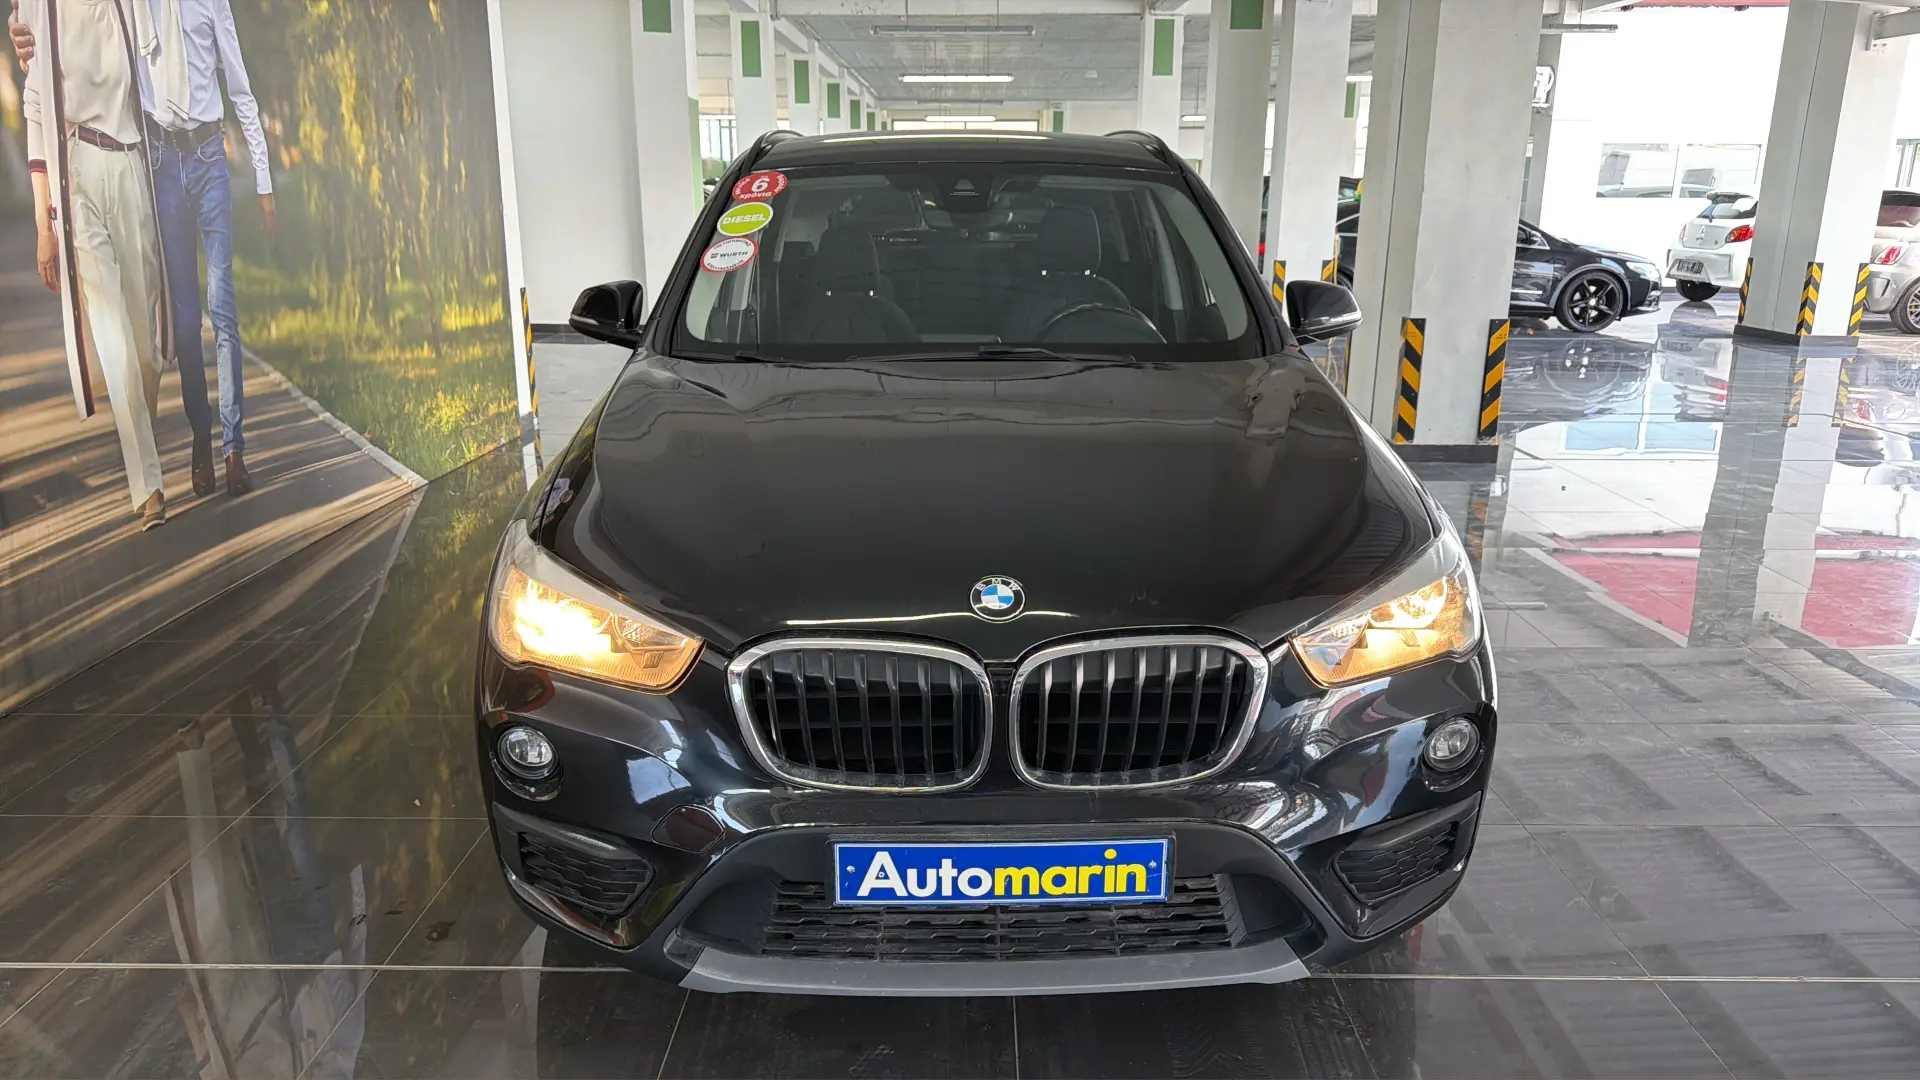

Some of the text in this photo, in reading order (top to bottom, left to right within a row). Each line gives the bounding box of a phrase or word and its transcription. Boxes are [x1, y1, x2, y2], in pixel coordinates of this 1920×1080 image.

[751, 177, 770, 192] 6
[722, 213, 766, 225] DIESEL
[856, 848, 1147, 897] Automarin
